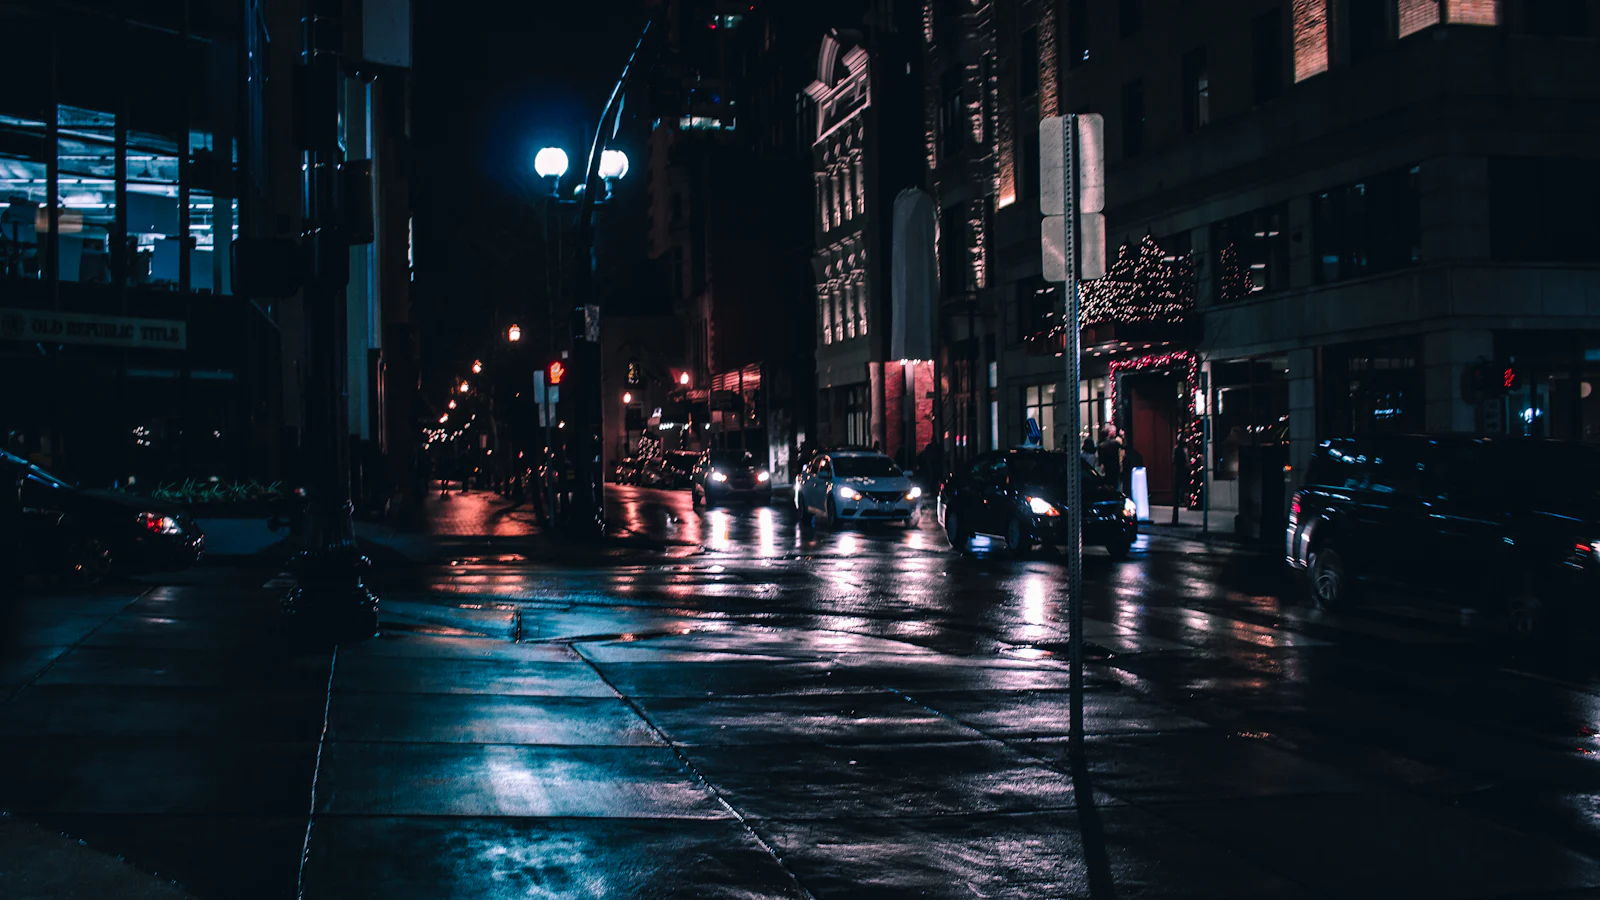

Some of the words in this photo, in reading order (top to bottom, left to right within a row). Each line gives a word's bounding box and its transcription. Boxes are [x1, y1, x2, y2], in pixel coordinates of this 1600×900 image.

[32, 318, 63, 335] OLD
[66, 320, 134, 339] REPUBLIC
[140, 325, 180, 342] TITLE
